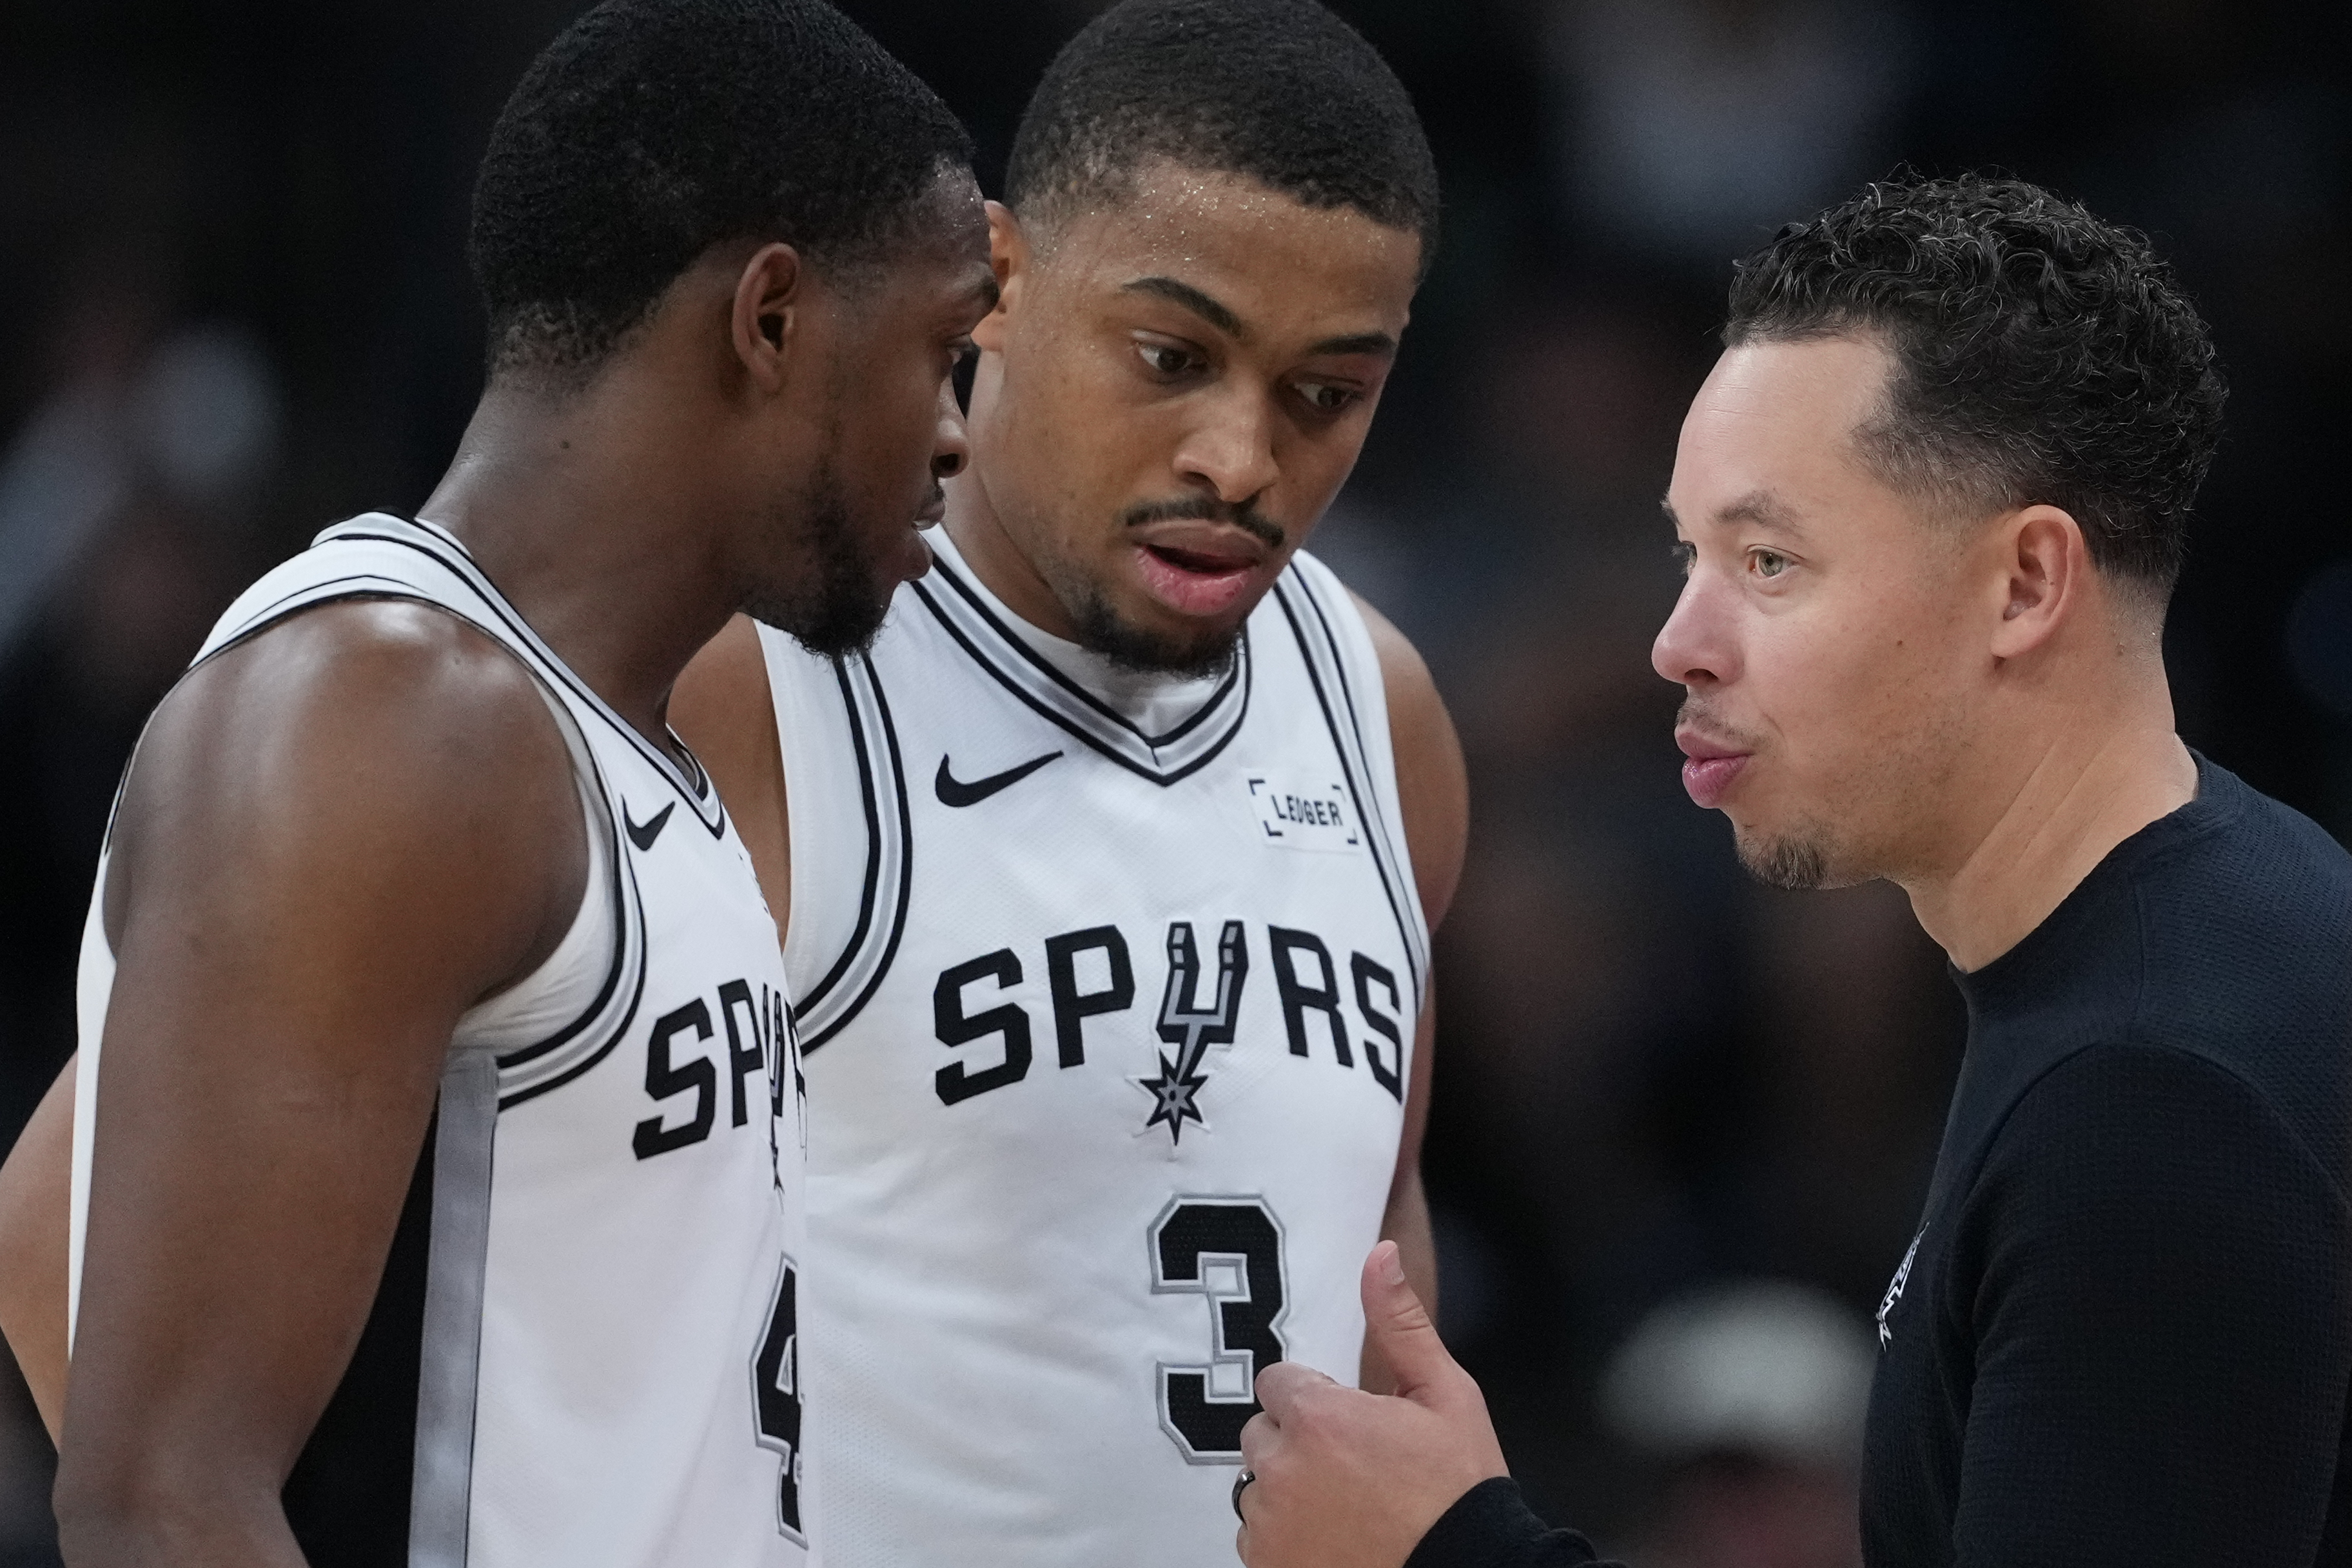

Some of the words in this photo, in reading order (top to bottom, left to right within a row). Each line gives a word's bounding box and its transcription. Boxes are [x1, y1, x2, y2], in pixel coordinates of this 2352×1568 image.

[633, 977, 808, 1194] SPUR
[934, 920, 1404, 1146] SPURS
[749, 1250, 808, 1551] 4
[1146, 1193, 1290, 1465] 3
